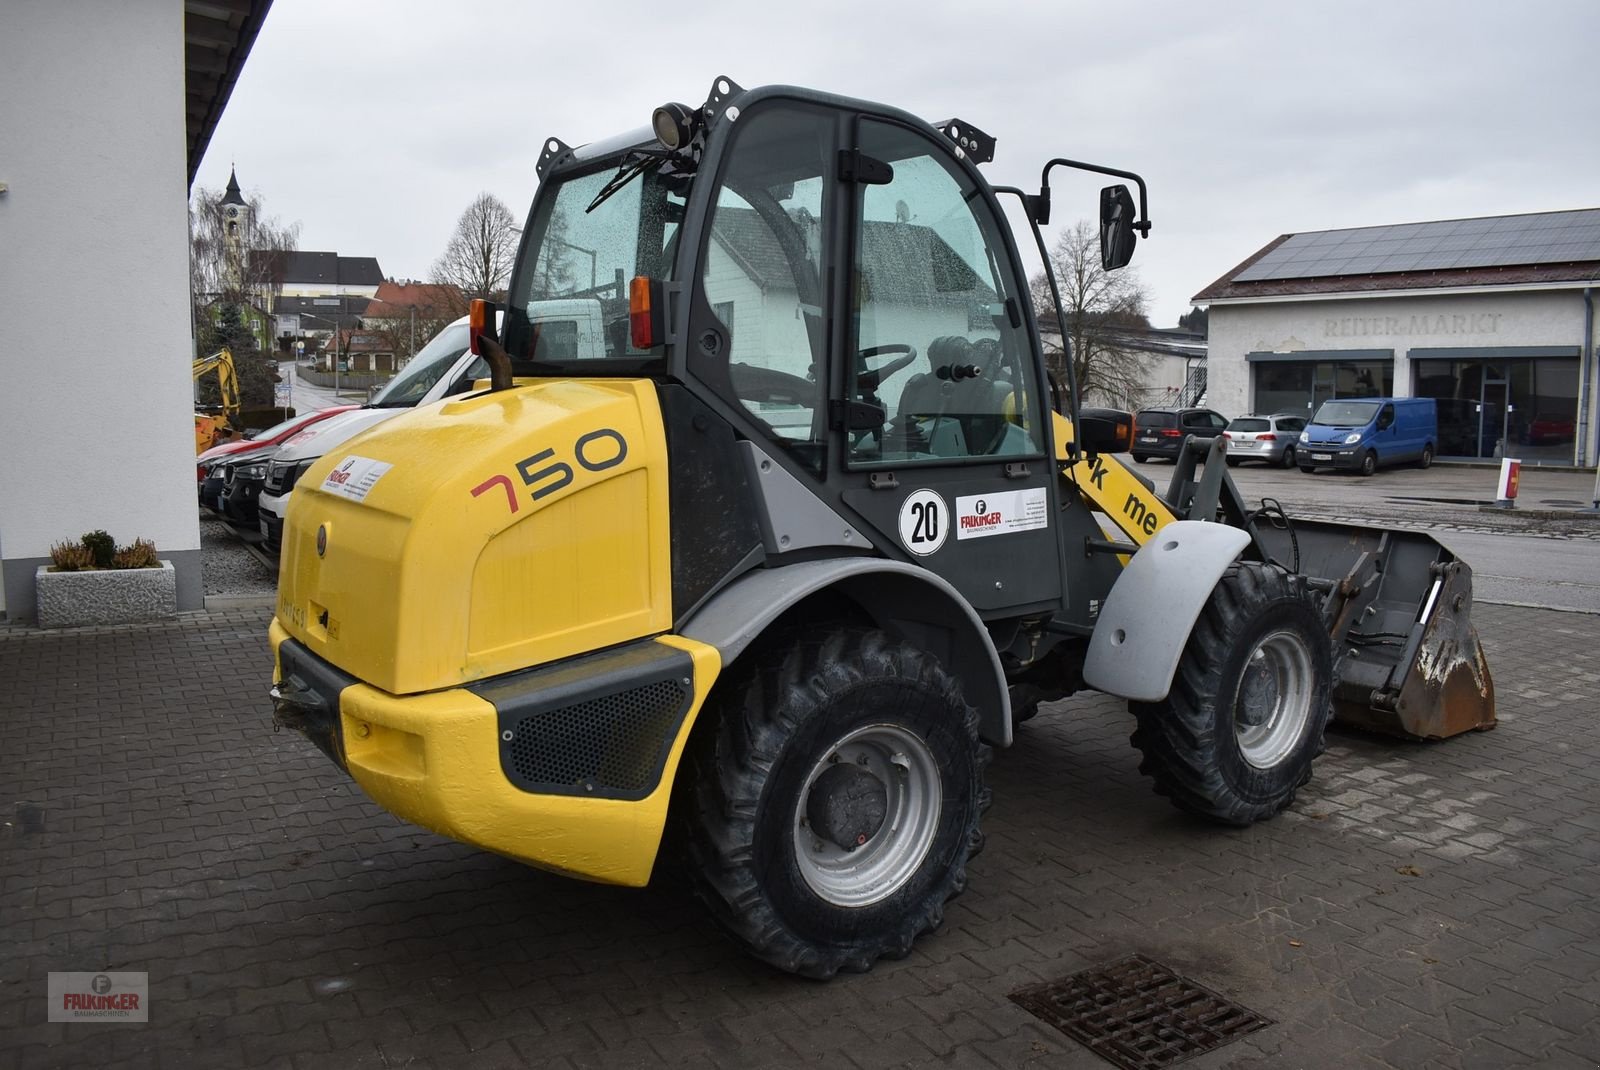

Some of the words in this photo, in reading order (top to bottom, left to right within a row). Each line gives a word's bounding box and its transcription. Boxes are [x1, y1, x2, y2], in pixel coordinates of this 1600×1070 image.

[1324, 313, 1503, 337] REITER-MARKT
[470, 428, 628, 514] 750
[911, 501, 938, 543] 20
[960, 512, 1002, 529] FALKINGER
